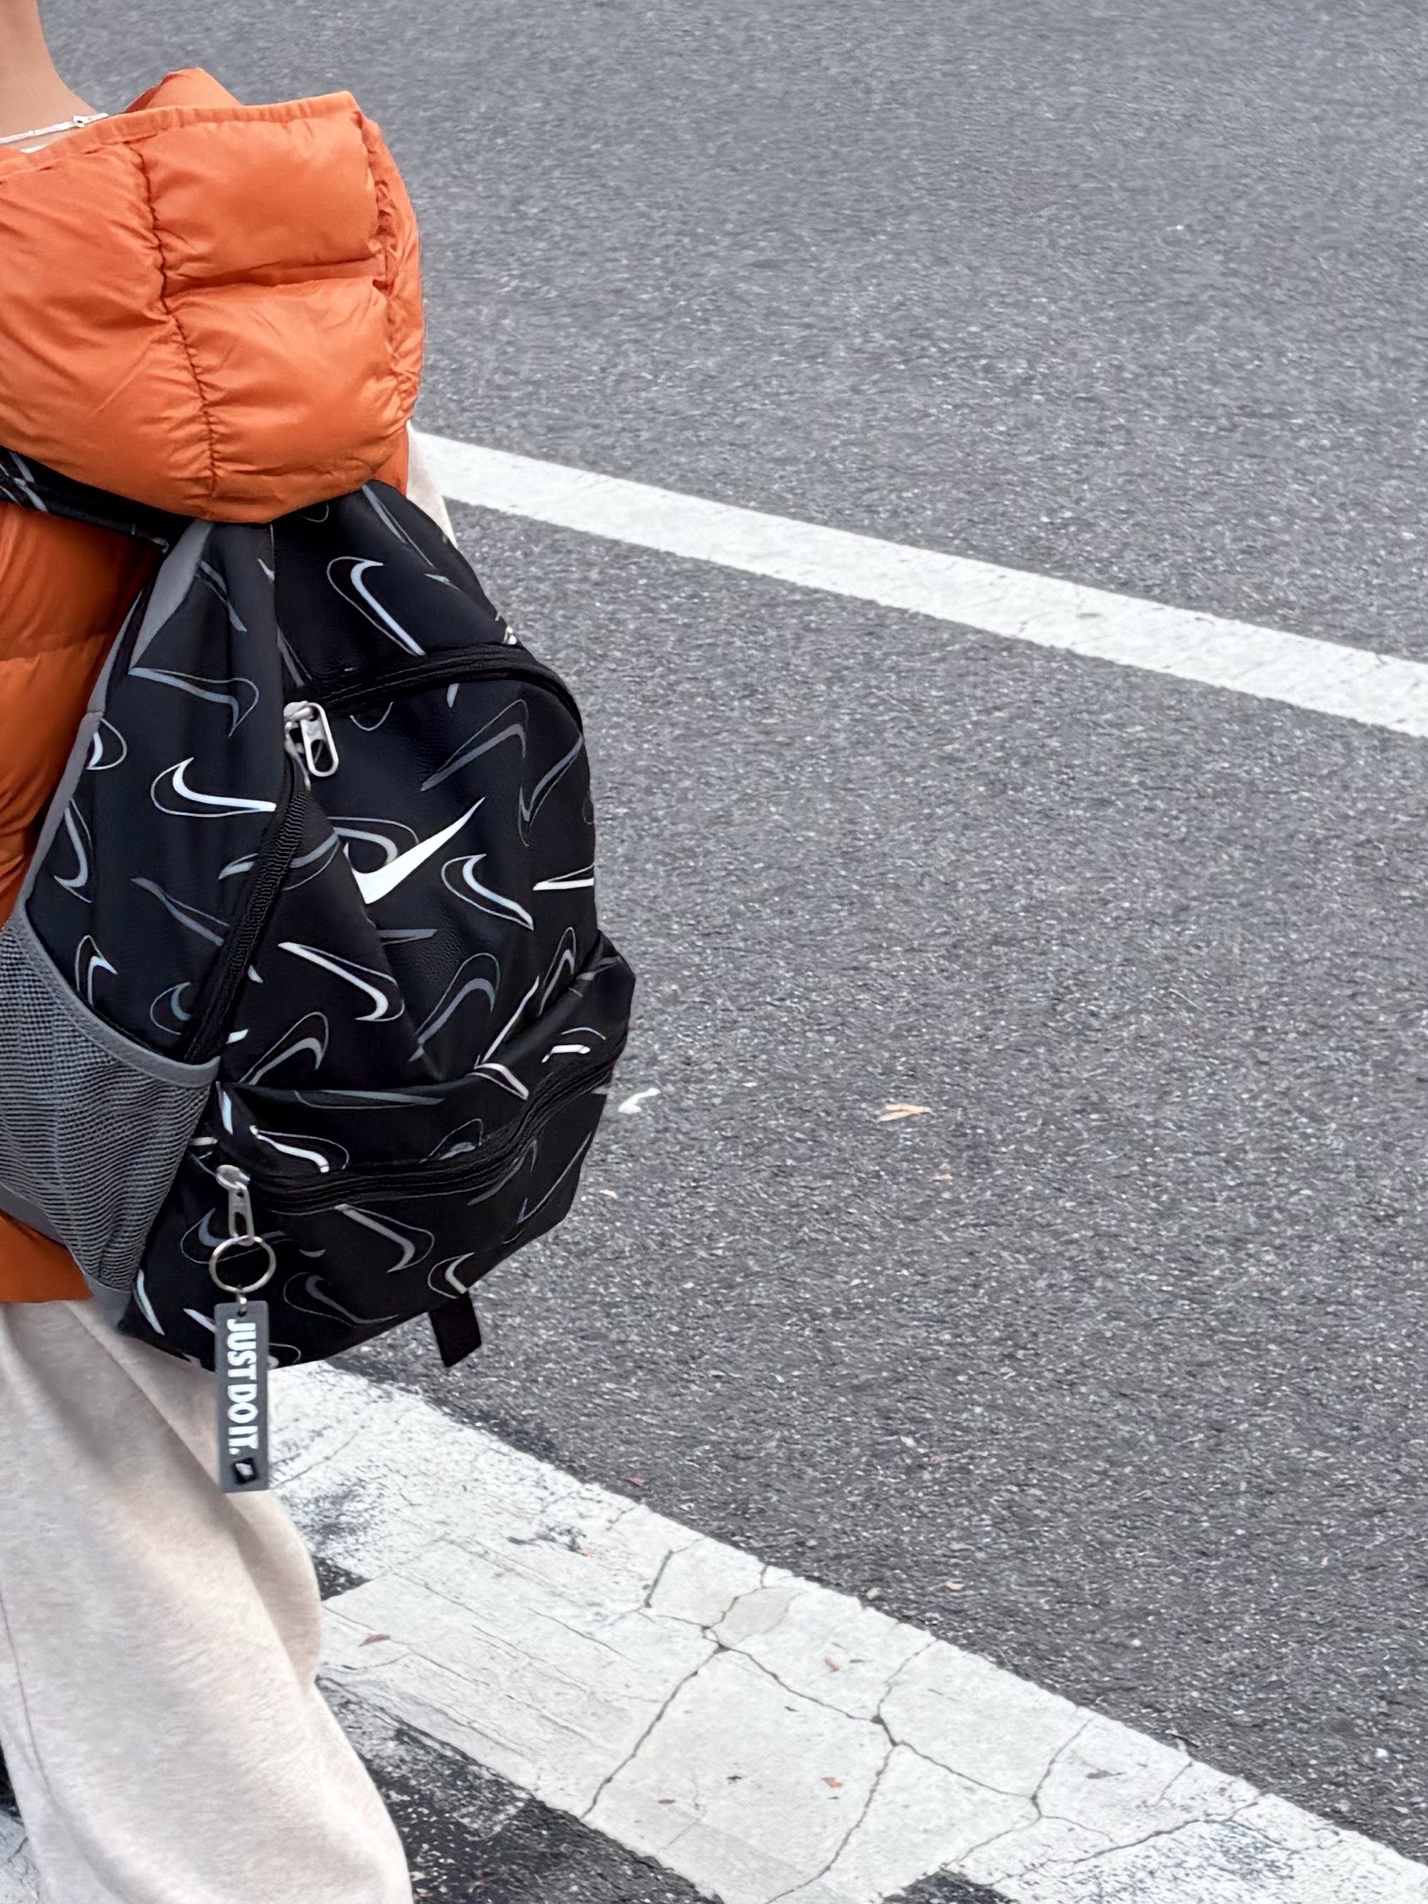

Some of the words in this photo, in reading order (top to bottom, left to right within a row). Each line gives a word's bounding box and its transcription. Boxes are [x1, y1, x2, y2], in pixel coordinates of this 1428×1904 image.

[226, 1318, 258, 1381] JUST
[227, 1383, 259, 1424] DO
[228, 1425, 259, 1455] IT.
